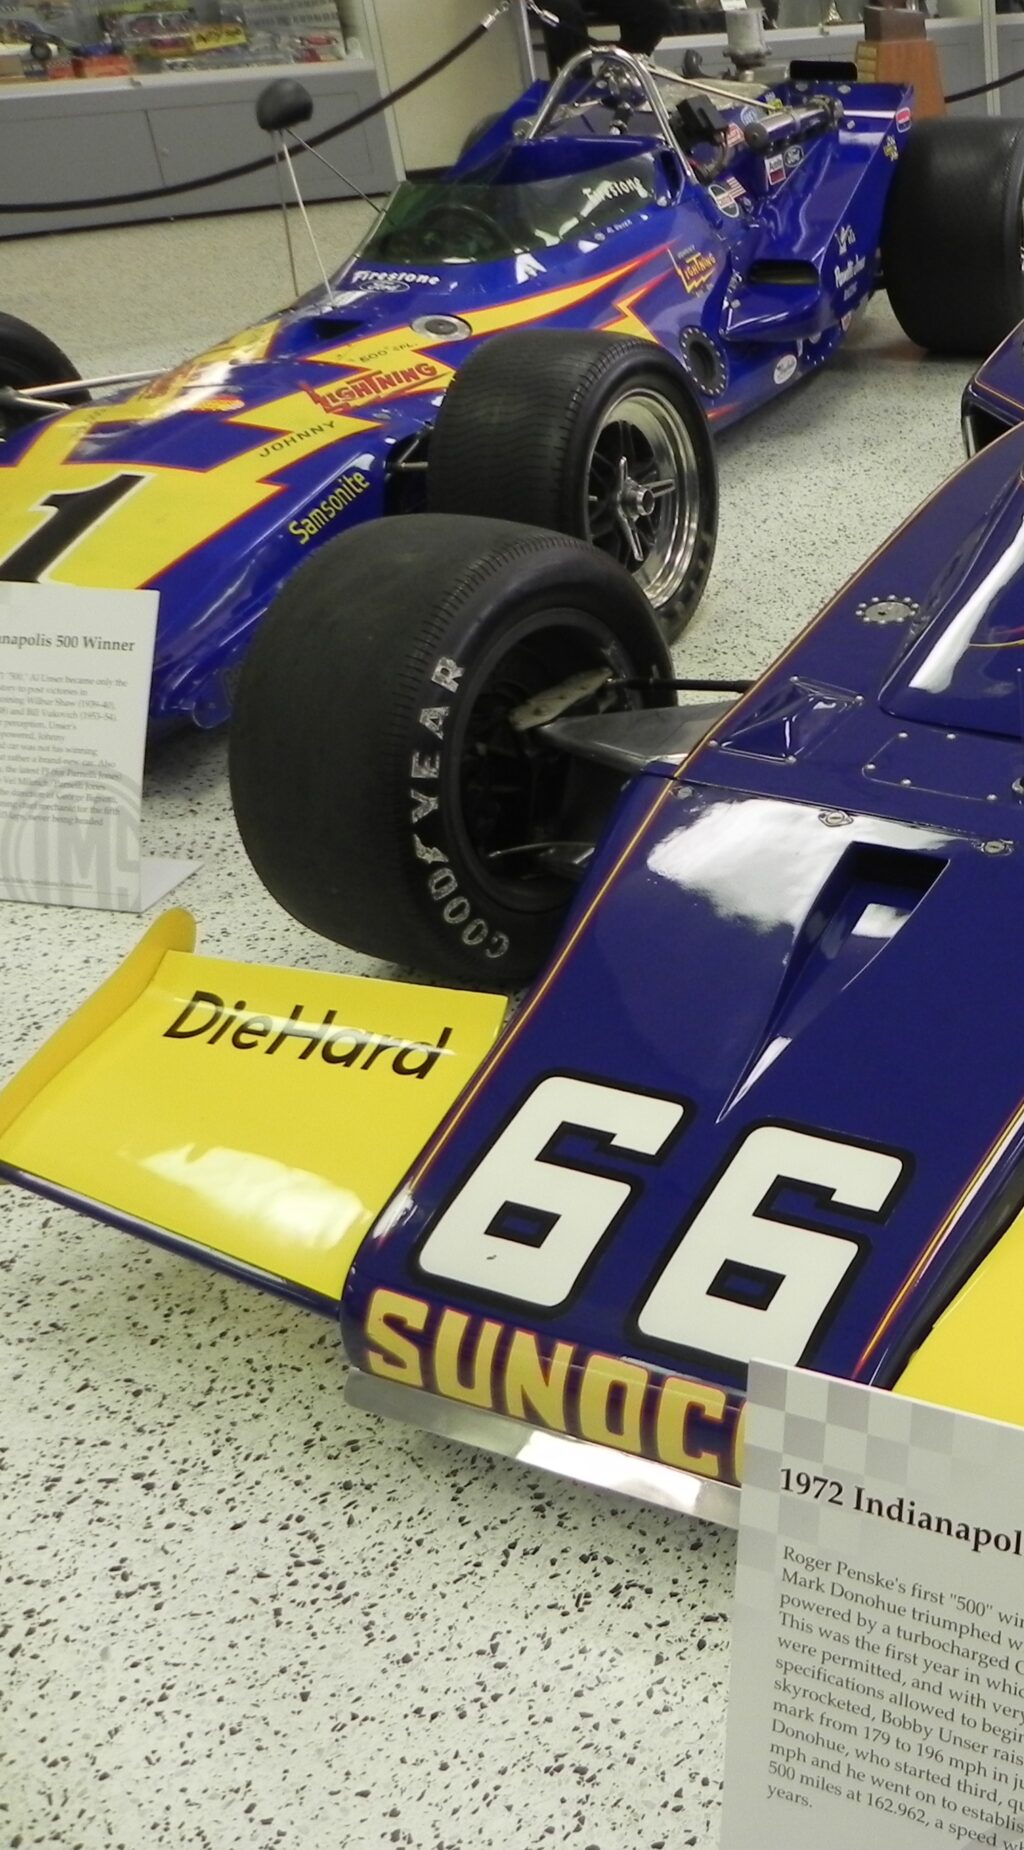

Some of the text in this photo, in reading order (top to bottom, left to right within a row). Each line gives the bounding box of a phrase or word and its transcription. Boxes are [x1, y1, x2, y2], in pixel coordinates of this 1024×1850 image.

[351, 270, 440, 286] Firestone
[298, 363, 438, 415] LIGHTNING
[259, 420, 336, 458] JOHNNY
[288, 469, 370, 545] Samsonite
[0, 633, 135, 652] napolis 500 Winner
[410, 656, 511, 960] GOODYEAR
[164, 990, 454, 1081] DieHard
[415, 1072, 908, 1371] 66
[365, 1287, 746, 1489] SUNOC
[780, 1467, 844, 1507] 1972
[781, 1567, 826, 1594] Mark
[829, 1581, 907, 1618] Donohue
[911, 1606, 1002, 1646] triumphed
[783, 1545, 833, 1573] Roger
[836, 1560, 907, 1595] Penske's
[910, 1582, 945, 1606] first
[778, 1610, 814, 1635] This
[818, 1626, 851, 1646] was
[854, 1634, 881, 1655] the
[884, 1642, 919, 1667] first
[921, 1658, 960, 1679] year
[963, 1666, 981, 1686] in
[779, 1593, 852, 1624] powered
[856, 1611, 878, 1635] by
[881, 1623, 891, 1636] a
[896, 1624, 1010, 1671] turbocharged
[775, 1658, 885, 1701] specifications
[888, 1691, 956, 1723] allowed
[960, 1712, 978, 1729] to
[777, 1636, 818, 1658] were
[820, 1649, 907, 1688] permitted,
[910, 1677, 943, 1697] and
[948, 1688, 987, 1710] with
[772, 1700, 815, 1723] mark
[818, 1711, 858, 1737] from
[863, 1725, 891, 1746] 179
[895, 1736, 912, 1753] to
[916, 1742, 945, 1764] 196
[948, 1756, 988, 1778] mph
[992, 1766, 1009, 1785] in
[773, 1677, 876, 1723] skyrocketed,
[881, 1708, 934, 1742] Bobby
[938, 1726, 989, 1755] Unser
[766, 1784, 813, 1809] years.
[769, 1743, 807, 1764] mph
[810, 1756, 842, 1775] and
[845, 1762, 866, 1783] he
[870, 1775, 912, 1798] went
[914, 1790, 937, 1806] on
[941, 1795, 958, 1813] to
[771, 1717, 850, 1758] Donohue,
[854, 1747, 891, 1769] who
[893, 1761, 952, 1789] started
[956, 1778, 1003, 1807] third,
[768, 1759, 796, 1781] 500
[799, 1773, 843, 1797] miles
[845, 1789, 862, 1804] at
[867, 1792, 930, 1828] 162.962,
[934, 1818, 944, 1830] a
[948, 1823, 998, 1848] speed
